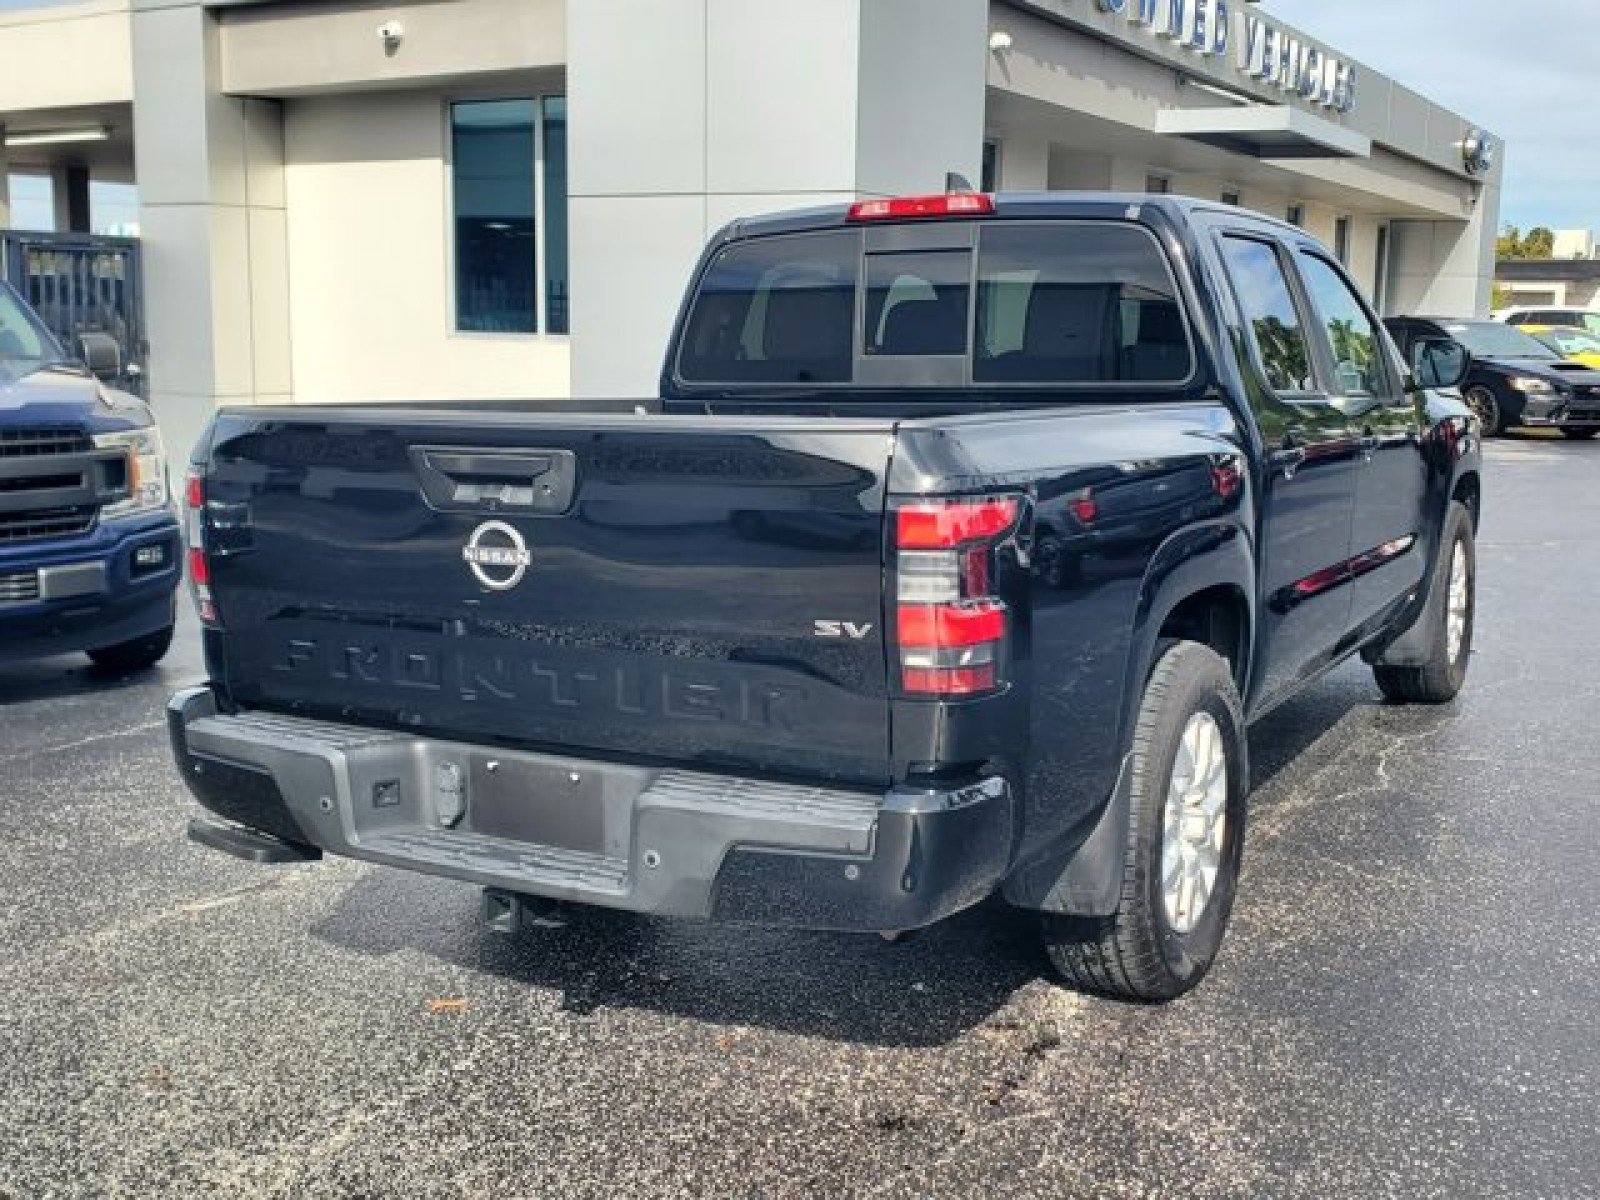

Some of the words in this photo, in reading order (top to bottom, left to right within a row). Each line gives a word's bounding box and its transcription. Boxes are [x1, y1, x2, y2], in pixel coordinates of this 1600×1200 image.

[1096, 0, 1226, 56] NED
[815, 620, 873, 638] SV
[271, 638, 812, 731] FRONTIER
